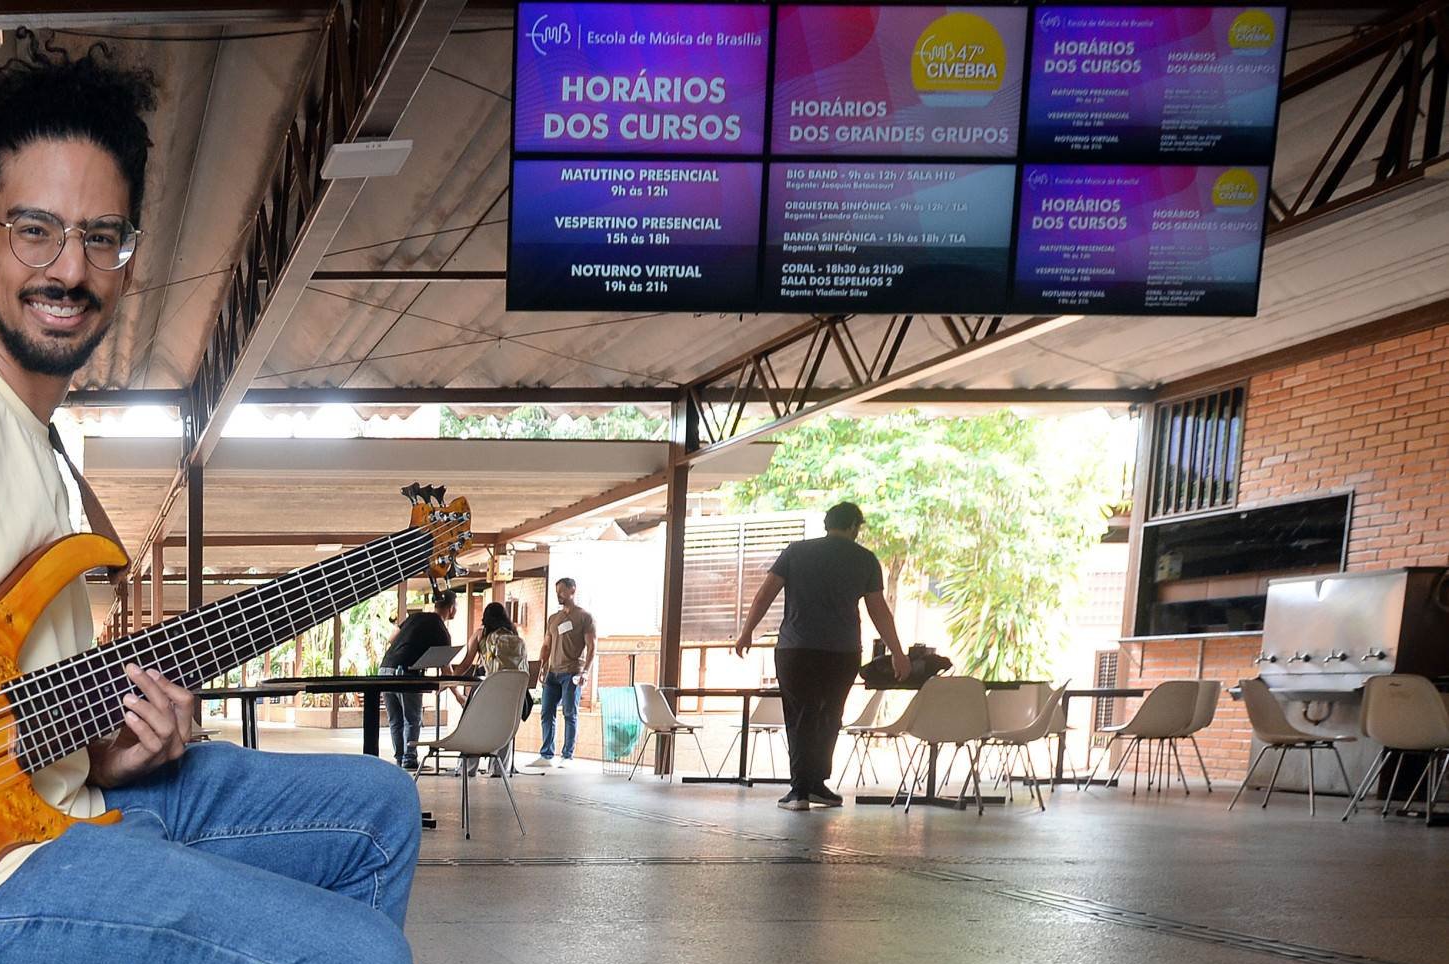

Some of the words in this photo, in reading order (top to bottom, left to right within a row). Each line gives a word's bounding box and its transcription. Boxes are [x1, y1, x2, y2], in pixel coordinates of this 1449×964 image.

[588, 31, 626, 45] Escola
[629, 31, 646, 45] de
[649, 31, 693, 46] Música
[696, 32, 713, 46] de
[716, 32, 762, 46] Brasília
[1053, 37, 1136, 55] HORÁRIOS
[925, 62, 998, 79] CIVEBRA
[1044, 60, 1078, 73] DOS
[1081, 60, 1143, 74] CURSOS
[561, 68, 726, 103] HORÁRIOS
[790, 96, 888, 118] HORÁRIOS
[543, 113, 610, 140] DOS
[619, 113, 742, 141] CURSOS
[789, 125, 830, 142] DOS
[835, 125, 926, 143] GRANDES
[931, 126, 1010, 144] GRUPOS
[561, 168, 635, 181] MATUTINO
[639, 169, 720, 182] PRESENCIAL
[808, 169, 838, 180] BAND
[879, 170, 897, 180] 12h
[907, 170, 932, 180] SALA
[611, 185, 626, 197] 9h
[629, 185, 643, 197] às
[647, 185, 669, 197] 12h
[785, 201, 839, 210] ORQUESTRA
[1041, 195, 1121, 212] HORÁRIOS
[554, 216, 638, 229] VESPERTINO
[642, 216, 722, 230] PRESENCIAL
[1032, 216, 1065, 230] DOS
[1068, 216, 1127, 230] CURSOS
[606, 233, 628, 245] 15h
[630, 233, 645, 245] às
[648, 233, 670, 245] 18h
[783, 232, 820, 242] BANDA
[886, 233, 905, 243] 15h
[948, 233, 966, 243] TLA
[571, 264, 642, 277] NOTURNO
[645, 264, 702, 278] VIRTUAL
[782, 263, 815, 273] CORAL
[826, 263, 857, 274] 18h30
[872, 264, 904, 274] 21h30
[604, 281, 626, 292] 19h
[629, 281, 643, 292] às
[645, 281, 668, 292] 21h
[781, 275, 807, 286] SALA
[809, 276, 831, 286] DOS
[833, 276, 884, 287] ESPELHOS
[886, 277, 893, 287] 2
